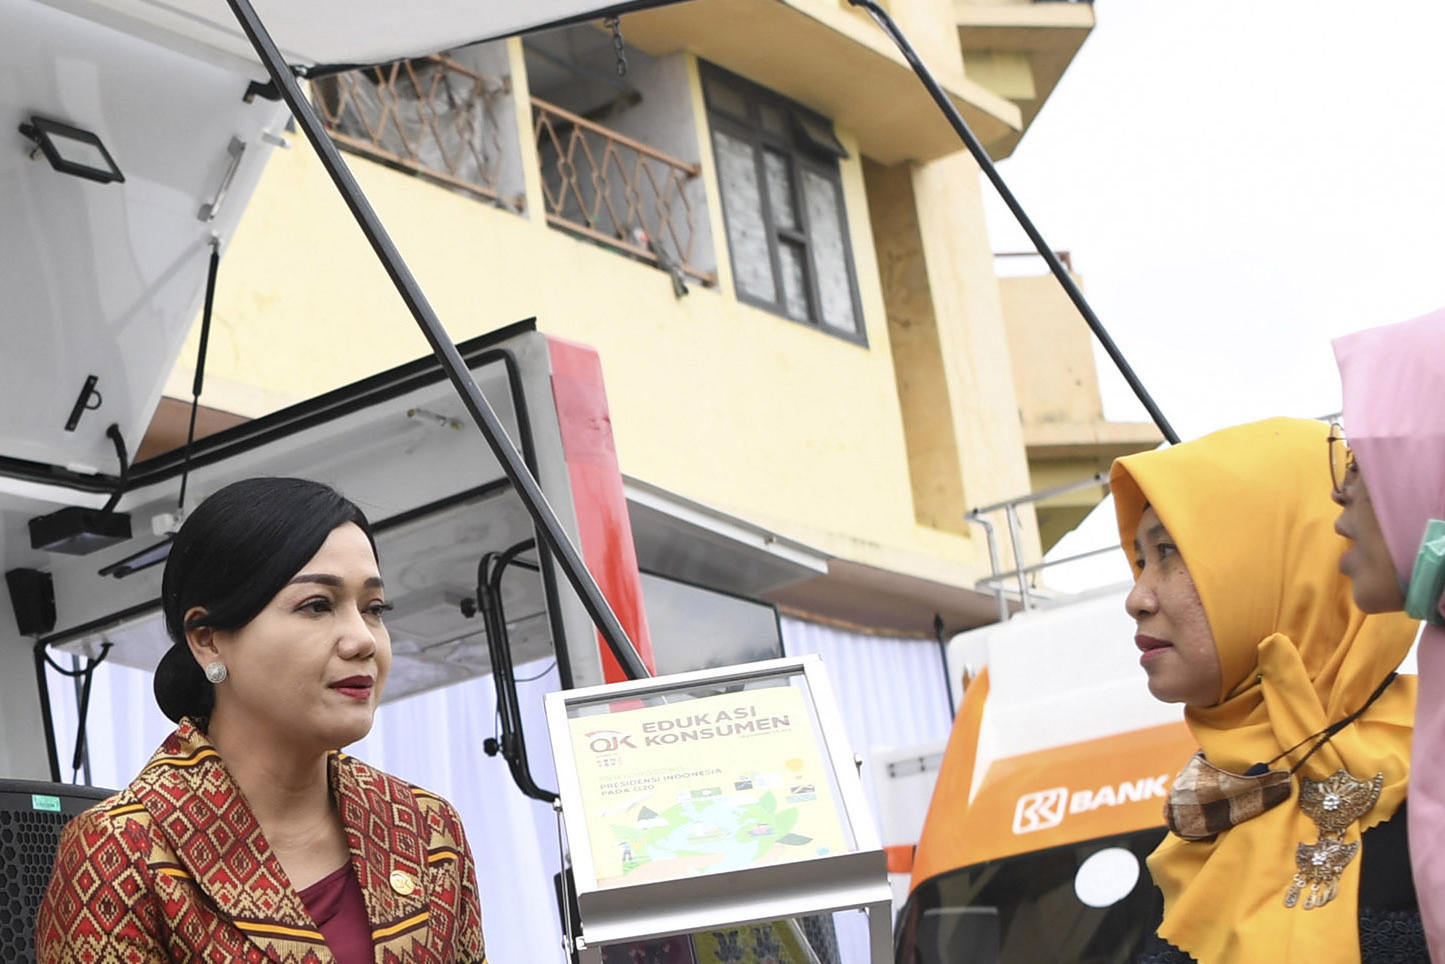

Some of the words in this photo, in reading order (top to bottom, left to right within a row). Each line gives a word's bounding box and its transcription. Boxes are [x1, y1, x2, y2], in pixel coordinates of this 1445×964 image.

[642, 705, 757, 733] EDUKASI
[645, 715, 791, 747] KONSUMEN
[600, 777, 660, 790] PRESIDENSI
[662, 768, 722, 781] INDONESIA
[1069, 775, 1170, 814] BANK
